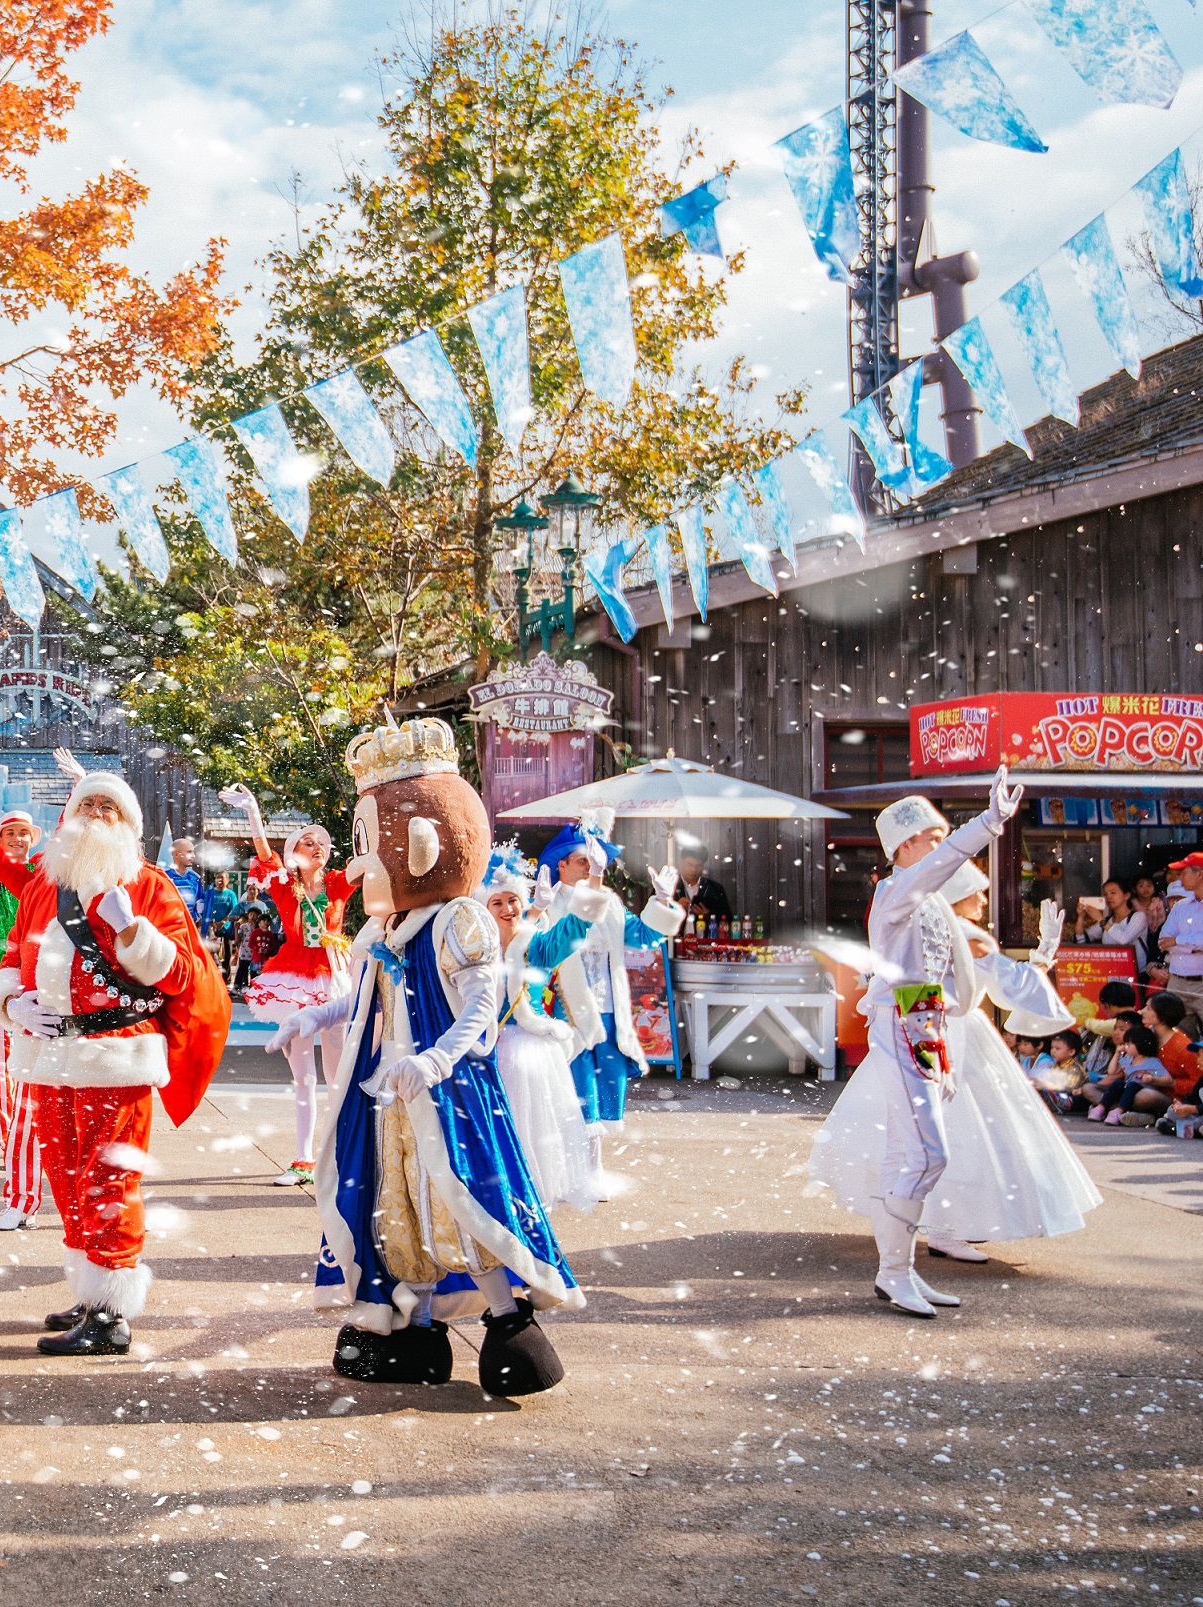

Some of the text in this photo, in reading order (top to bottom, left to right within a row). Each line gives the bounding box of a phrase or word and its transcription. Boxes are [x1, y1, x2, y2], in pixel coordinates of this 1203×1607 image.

[476, 679, 607, 707] EL DORADO SALOON
[514, 698, 569, 716] 牛排館
[960, 706, 989, 724] FRESH
[1056, 697, 1099, 716] HOT
[1102, 696, 1160, 715] 爆米花
[513, 717, 570, 730] RESTAURANT
[918, 712, 936, 732] HOT
[920, 725, 987, 764] POPCORN
[1039, 716, 1203, 770] POPCOR
[1066, 962, 1092, 974] $75
